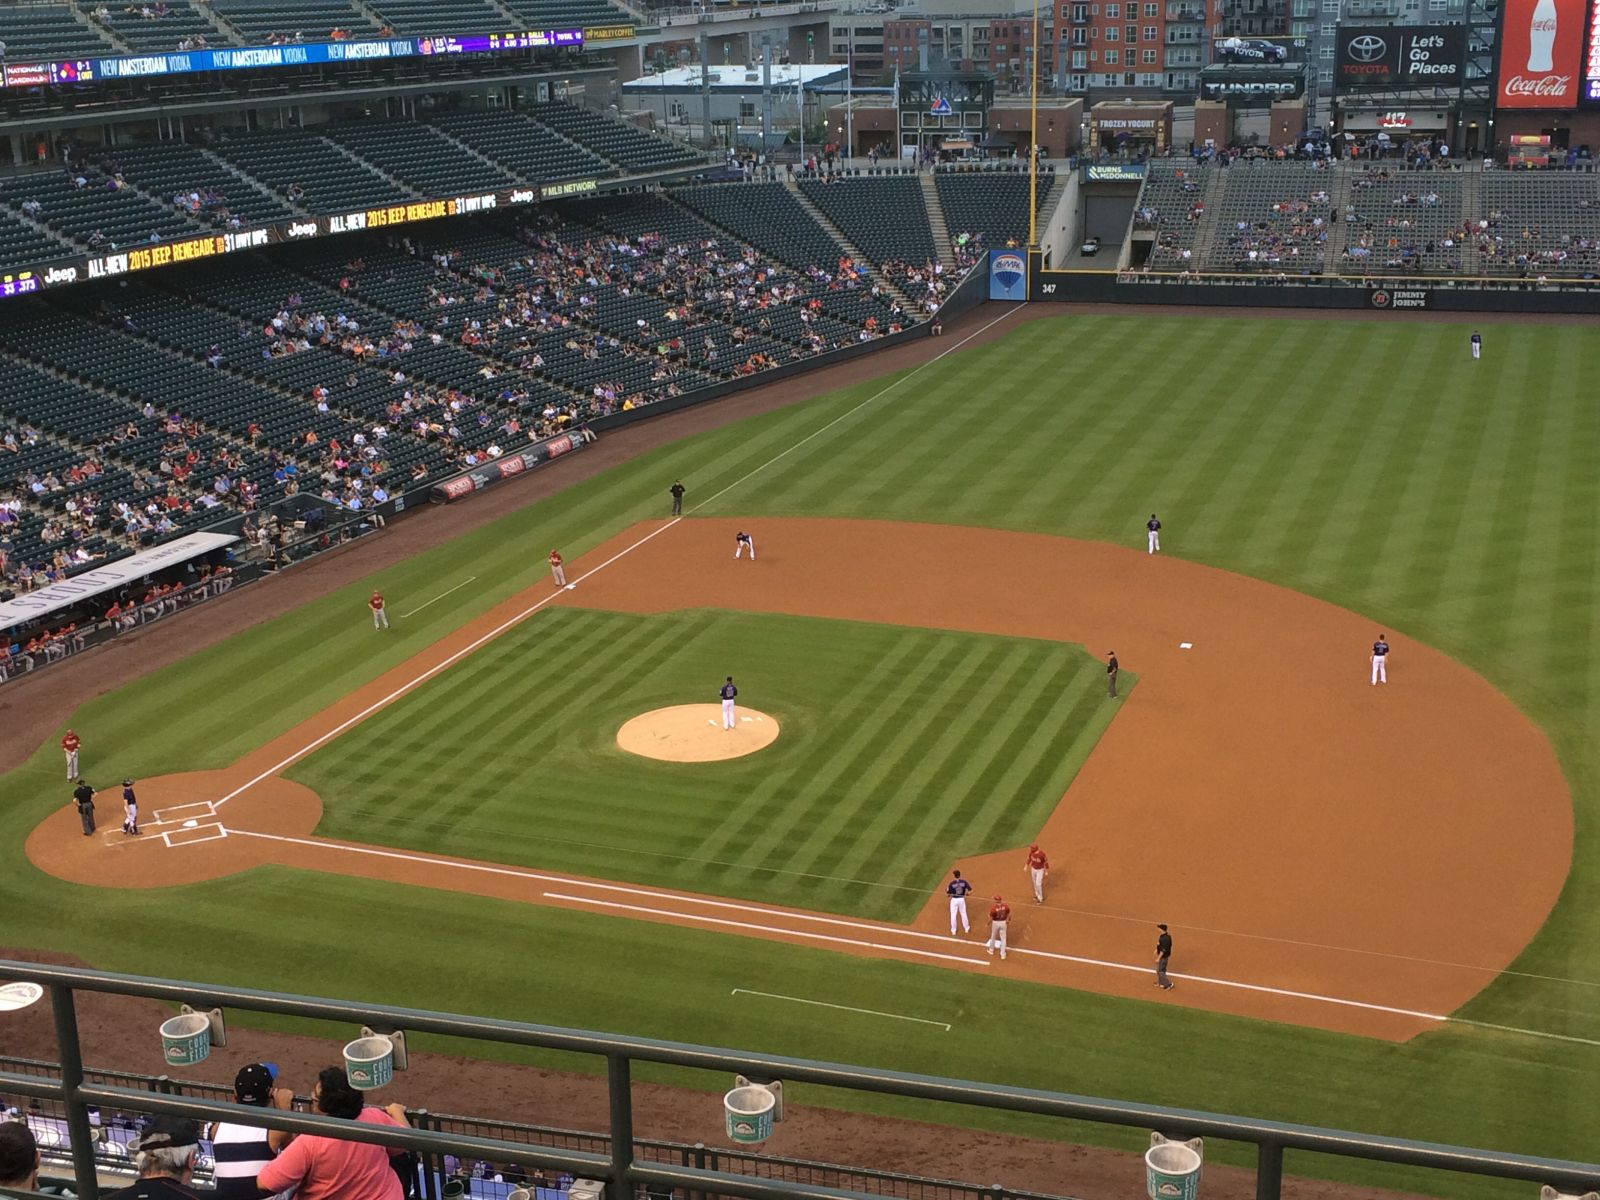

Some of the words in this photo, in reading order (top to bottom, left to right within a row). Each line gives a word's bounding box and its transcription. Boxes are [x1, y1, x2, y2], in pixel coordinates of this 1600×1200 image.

[1411, 35, 1444, 47] Let's
[328, 45, 343, 58] NEW
[344, 42, 389, 58] AMSTERDAM
[391, 41, 412, 56] VODKA
[1234, 47, 1264, 58] TOYOTA
[1410, 49, 1429, 61] Go
[213, 52, 231, 67] NEW
[232, 49, 282, 67] AMSTERDAM
[283, 48, 307, 63] VODKA
[100, 59, 117, 76] NEW
[119, 56, 167, 75] AMSTERDAM
[168, 55, 191, 71] VODKA
[1343, 65, 1389, 74] TOYOTA
[1409, 62, 1456, 74] Places
[1205, 83, 1296, 94] TUNDRA
[1505, 75, 1572, 96] Coca-Cola
[548, 186, 563, 196] MLB
[564, 181, 597, 194] NETWORK
[510, 190, 534, 203] Jeep
[330, 212, 366, 233] ALL-NEW
[367, 210, 387, 228] 2015
[388, 206, 405, 224] JEEP
[407, 200, 446, 220] RENEGADE
[288, 222, 317, 237] Jeep
[88, 254, 128, 279] ALL-NEW
[129, 249, 151, 270] 2015
[151, 246, 171, 266] JEEP
[173, 238, 216, 263] RENEGADE
[224, 233, 235, 253] 31
[45, 267, 76, 283] Jeep
[1042, 284, 1056, 293] 347
[1393, 291, 1426, 300] JIMMY
[1392, 300, 1425, 308] JOHN'S
